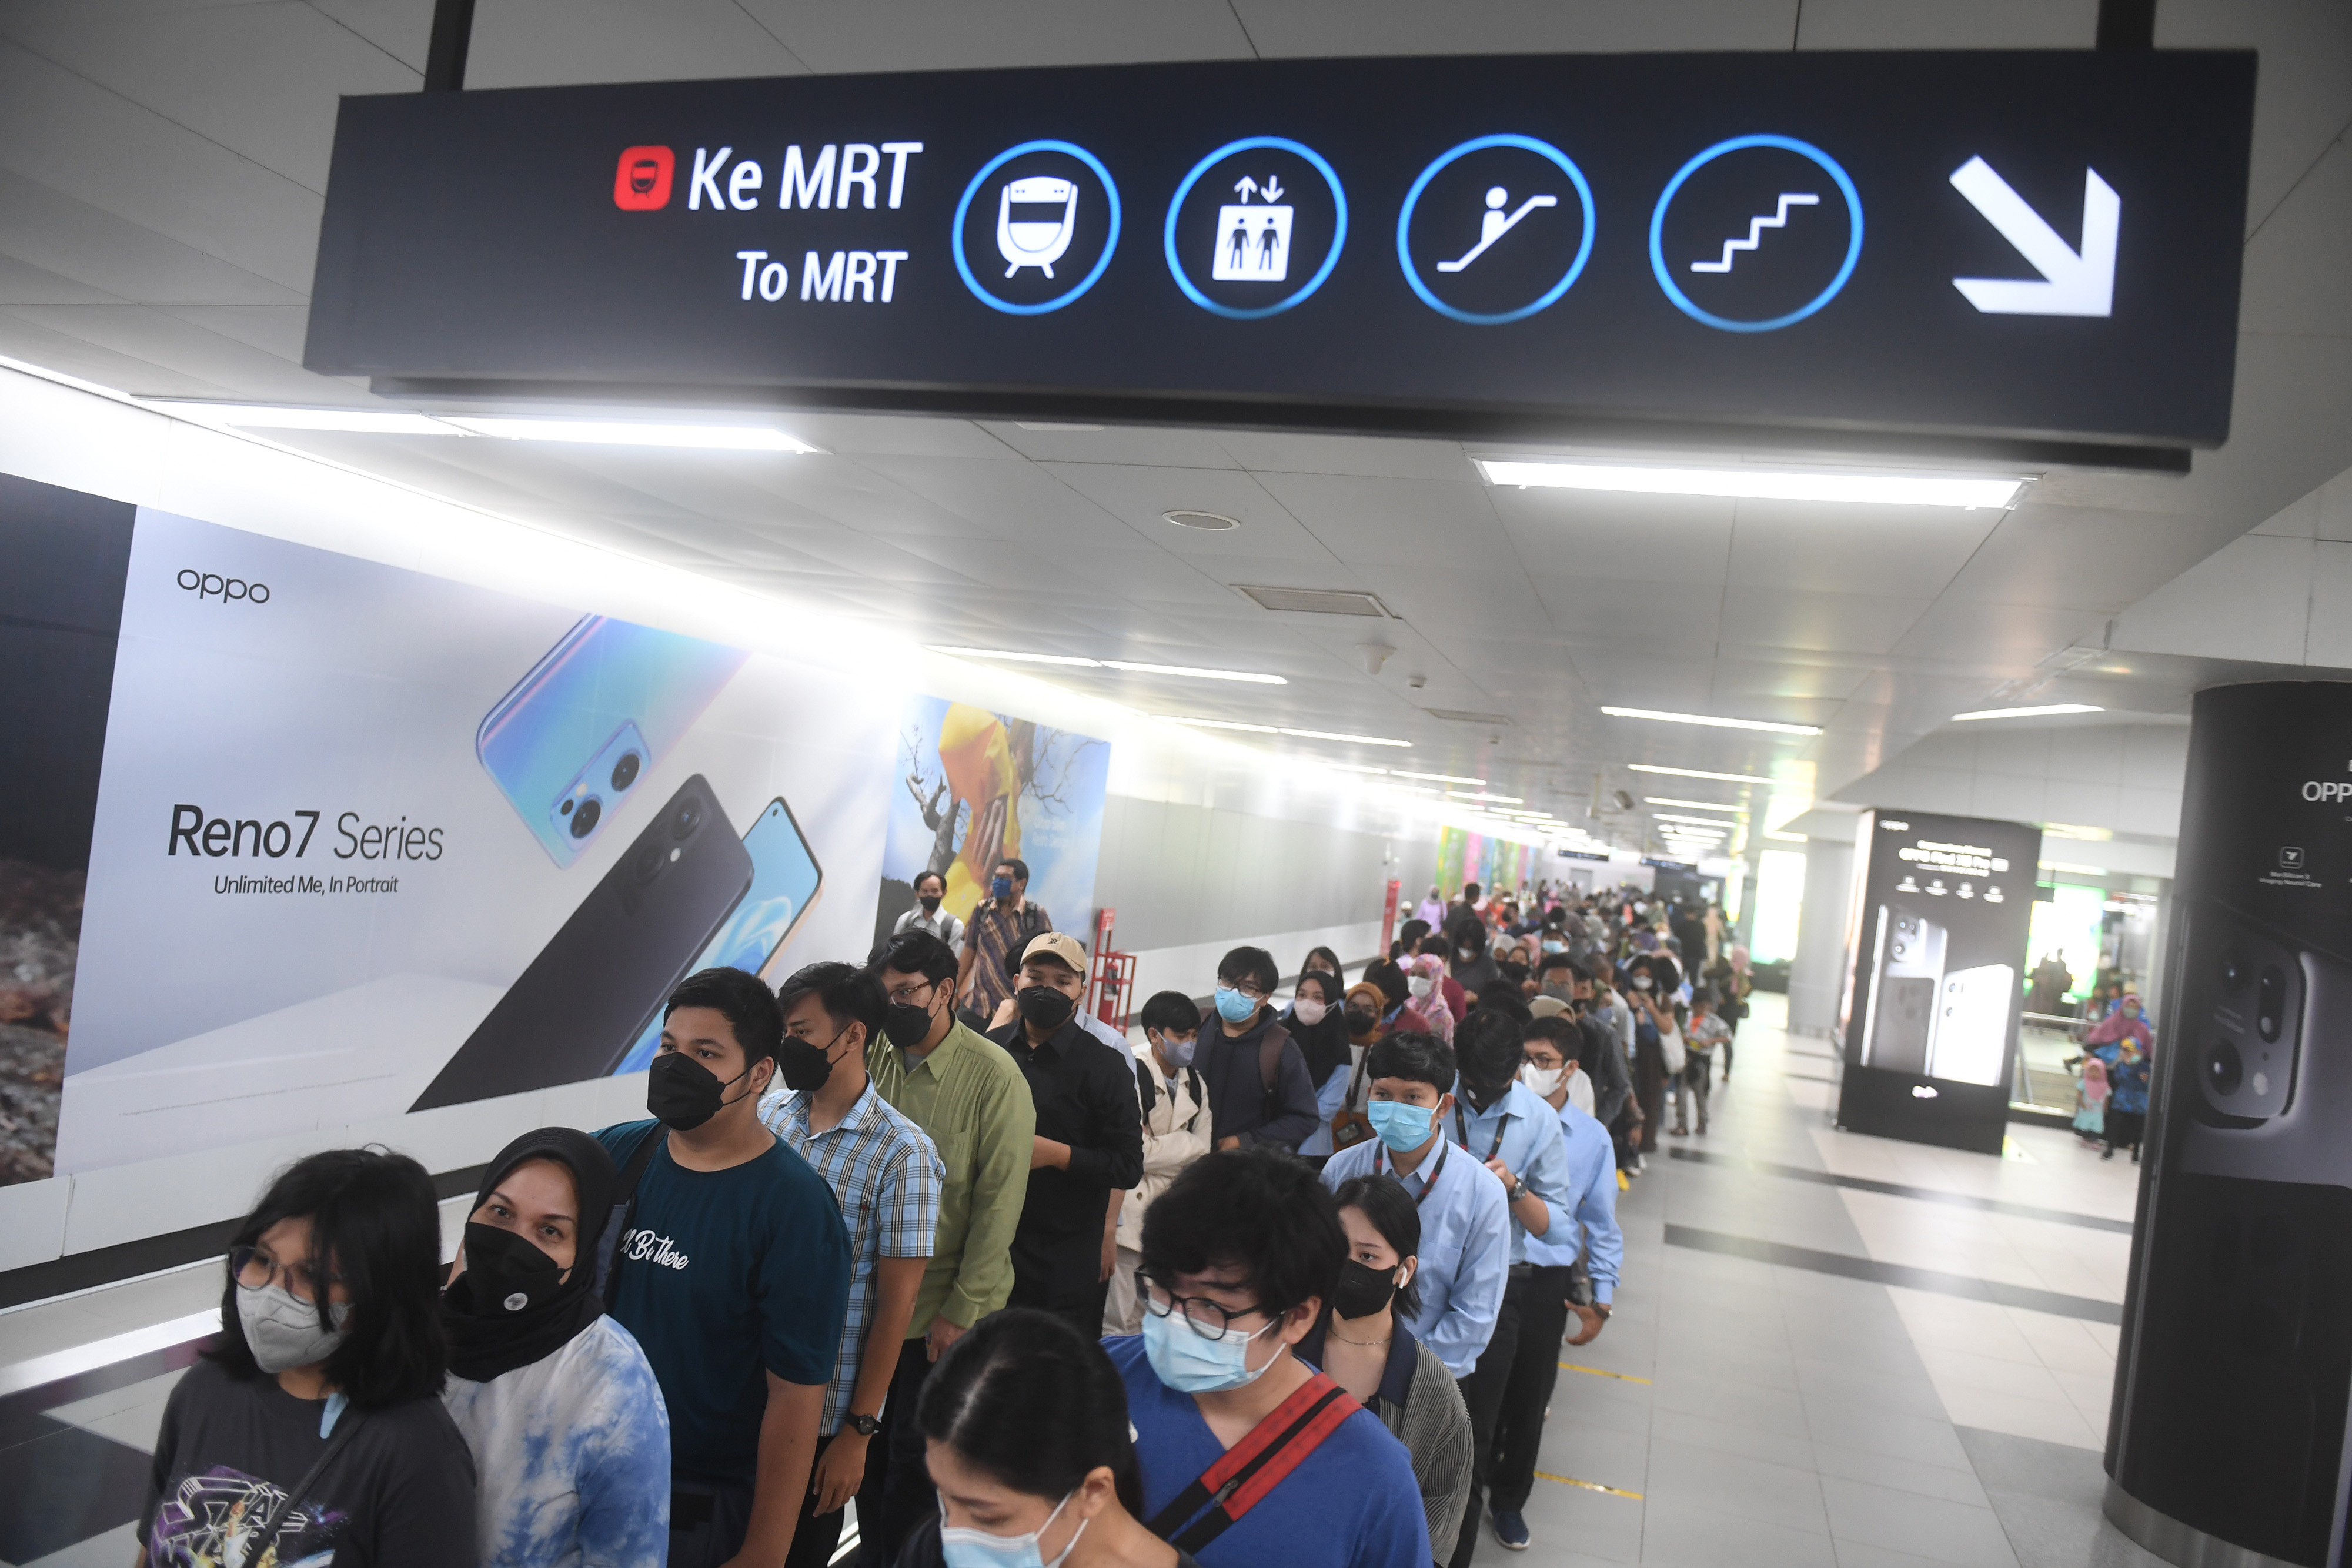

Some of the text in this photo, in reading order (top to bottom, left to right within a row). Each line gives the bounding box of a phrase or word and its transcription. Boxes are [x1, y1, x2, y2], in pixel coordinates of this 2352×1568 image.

[688, 142, 924, 212] Ke MRT
[736, 250, 909, 303] To MRT
[177, 569, 270, 604] oppo
[168, 804, 444, 860] Reno7 Series
[214, 875, 399, 895] Unlimited Me, In Portrait
